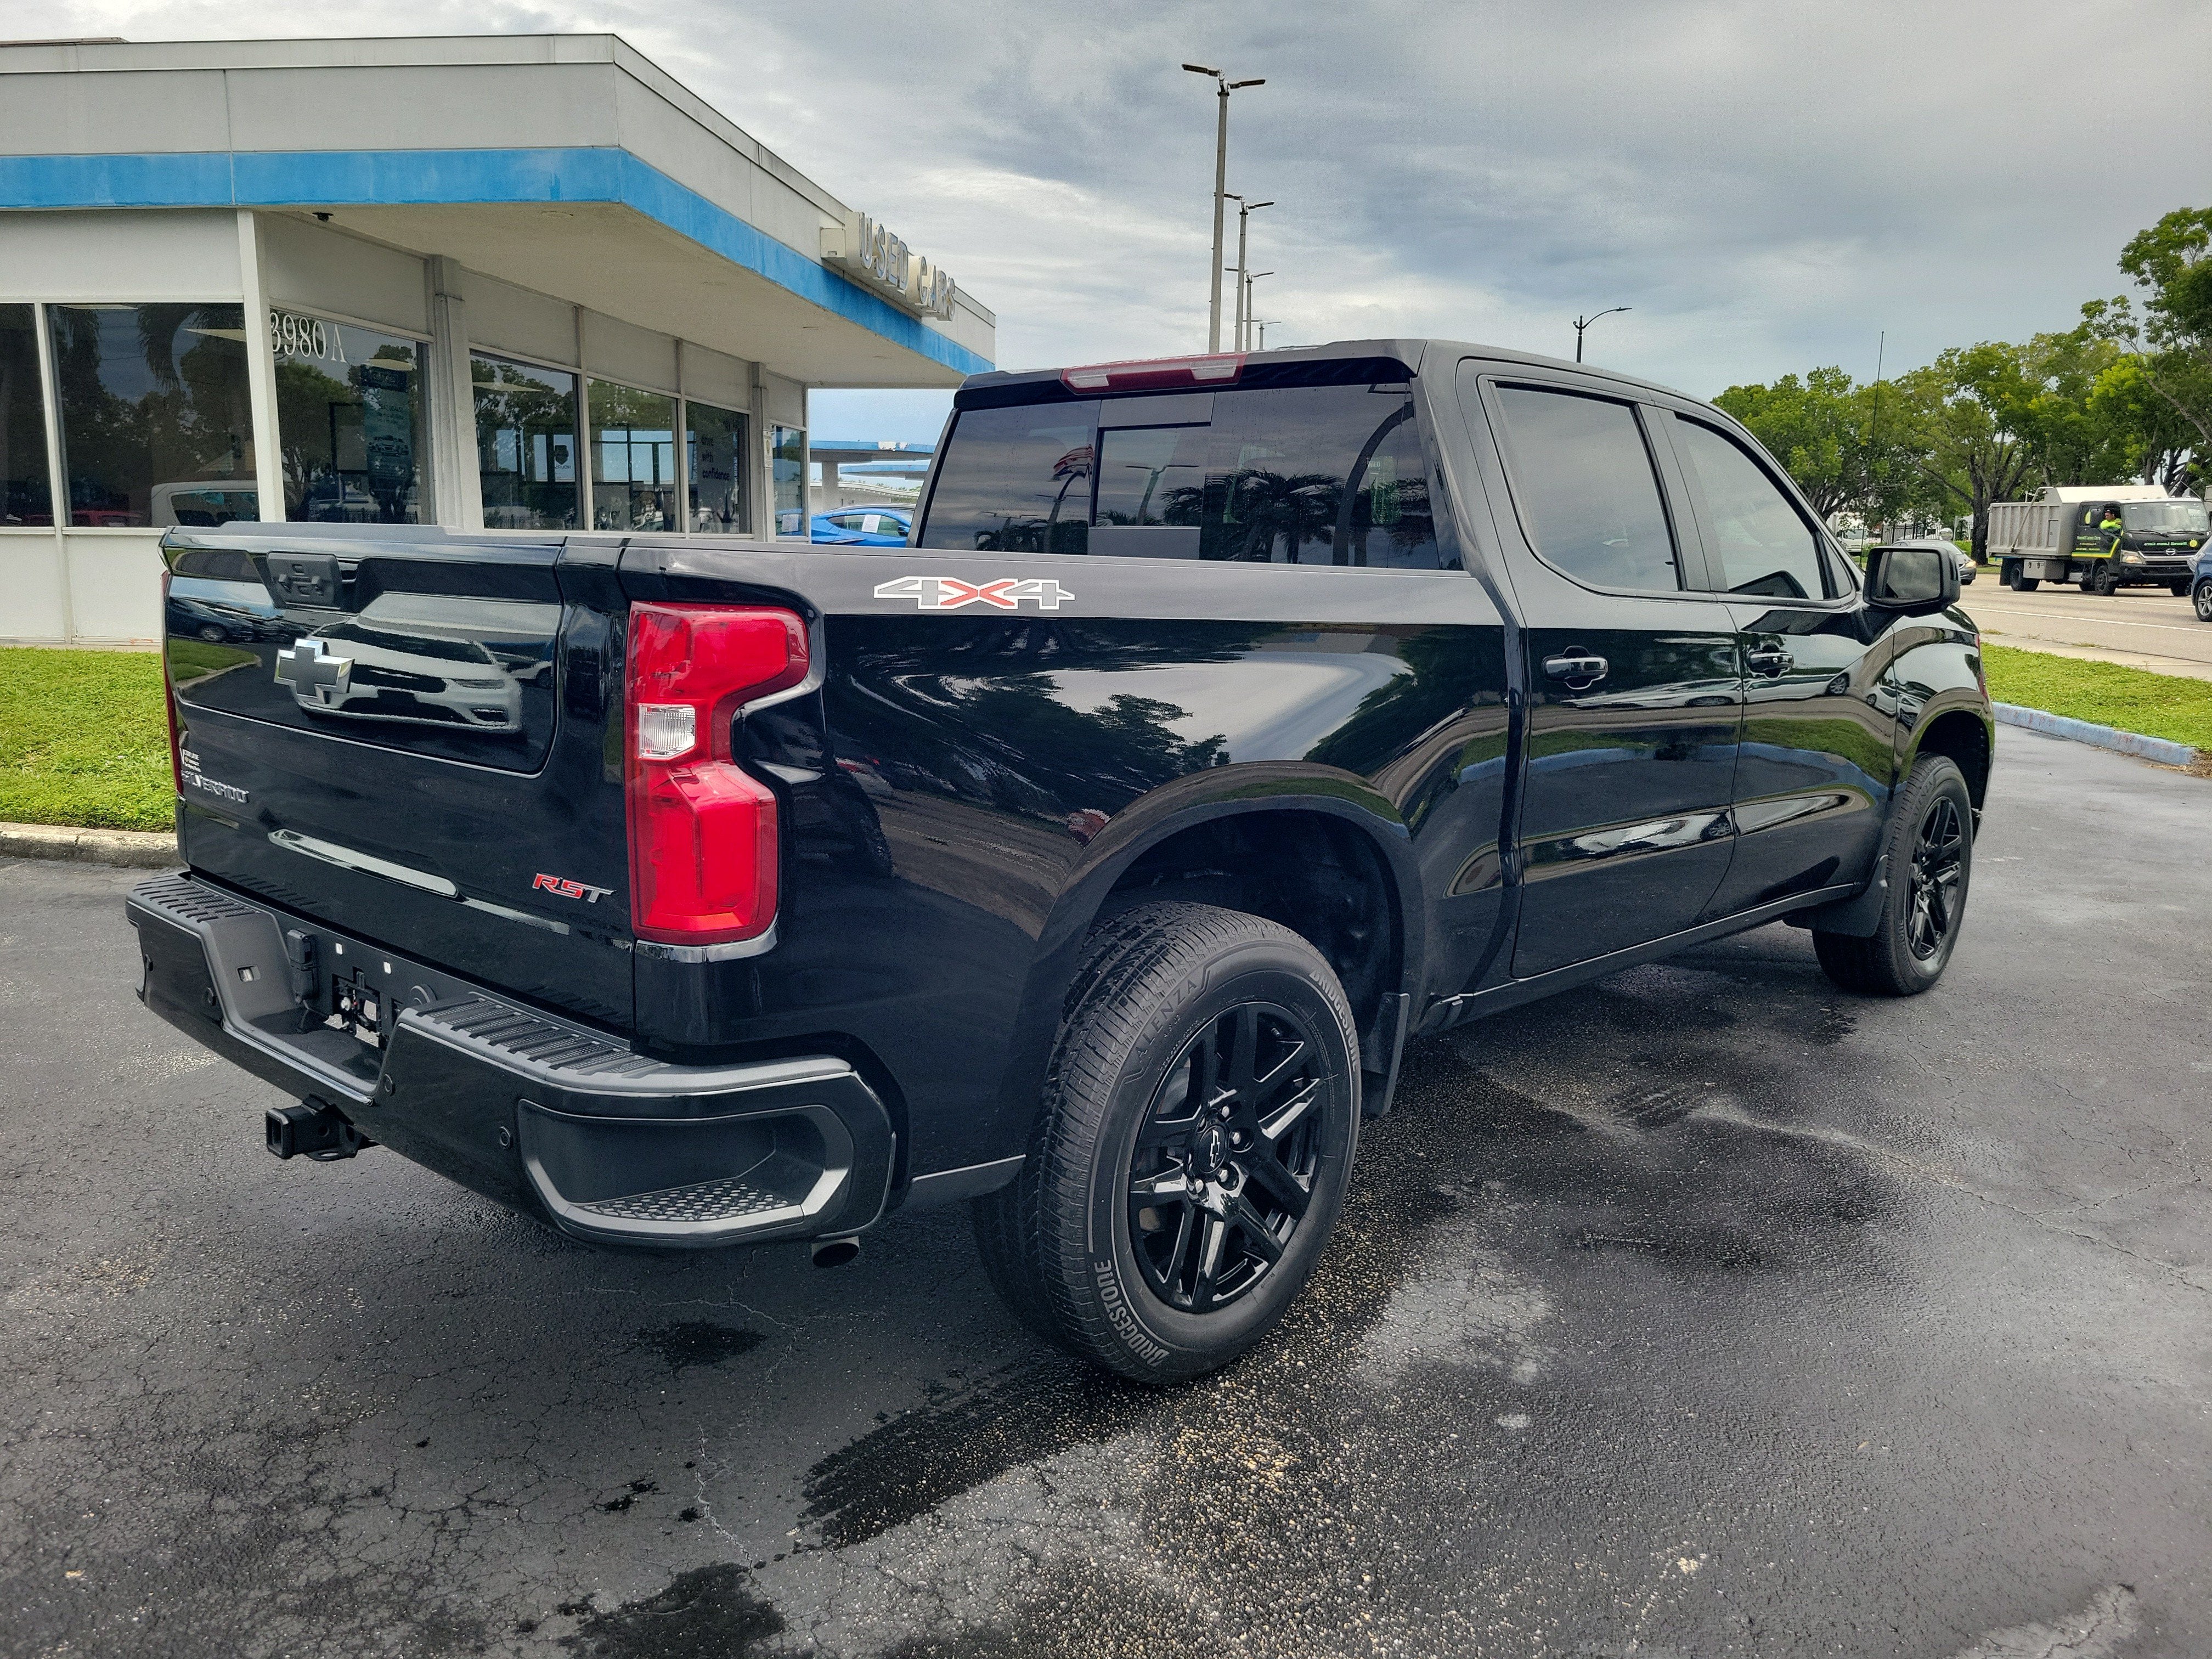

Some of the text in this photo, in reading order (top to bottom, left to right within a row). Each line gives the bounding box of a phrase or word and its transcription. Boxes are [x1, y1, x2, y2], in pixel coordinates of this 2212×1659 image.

[856, 212, 956, 321] USED CARS
[270, 312, 347, 363] 3980 A
[181, 770, 250, 804] SILVERADO
[532, 873, 617, 904] RST
[1135, 979, 1198, 1058] ALENZA
[1309, 969, 1357, 1073] BRIDGESTONE
[1094, 1259, 1171, 1368] BRIDGESTONE
